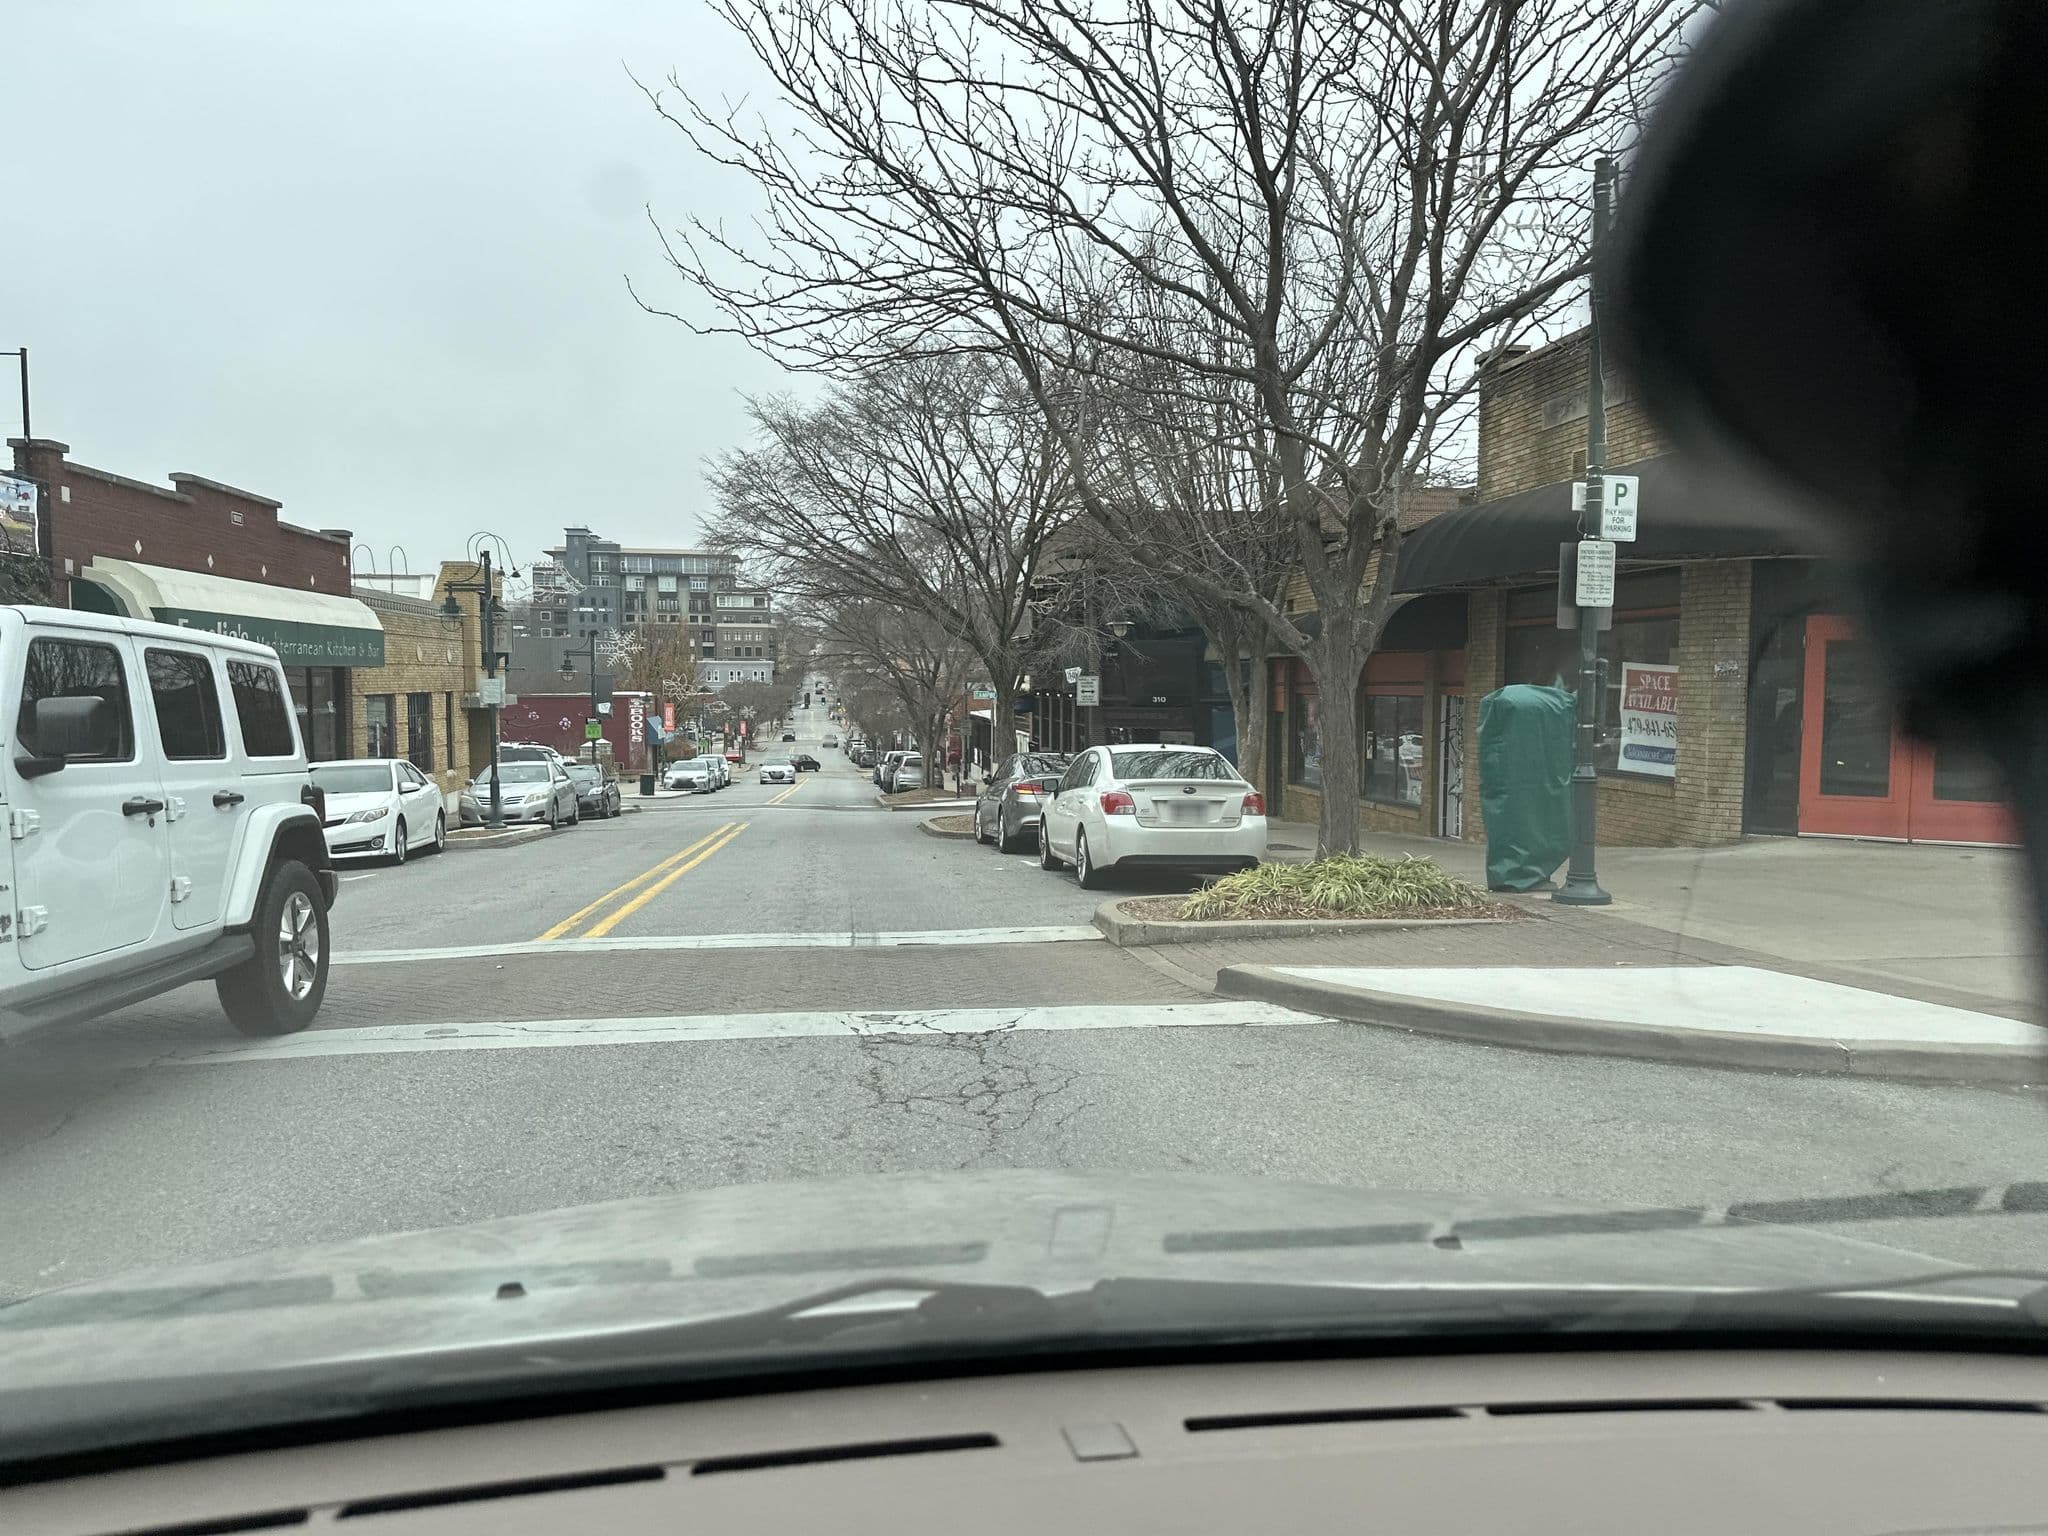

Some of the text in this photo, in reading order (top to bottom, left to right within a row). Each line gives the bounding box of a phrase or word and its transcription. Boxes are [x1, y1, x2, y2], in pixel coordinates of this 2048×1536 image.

[1615, 483, 1628, 506] P
[1604, 524, 1632, 533] PARKING
[1612, 516, 1625, 525] FOR
[327, 635, 356, 657] Kitchen
[367, 642, 379, 657] Bar
[1640, 674, 1671, 691] SPACE
[630, 708, 644, 743] BOOKS
